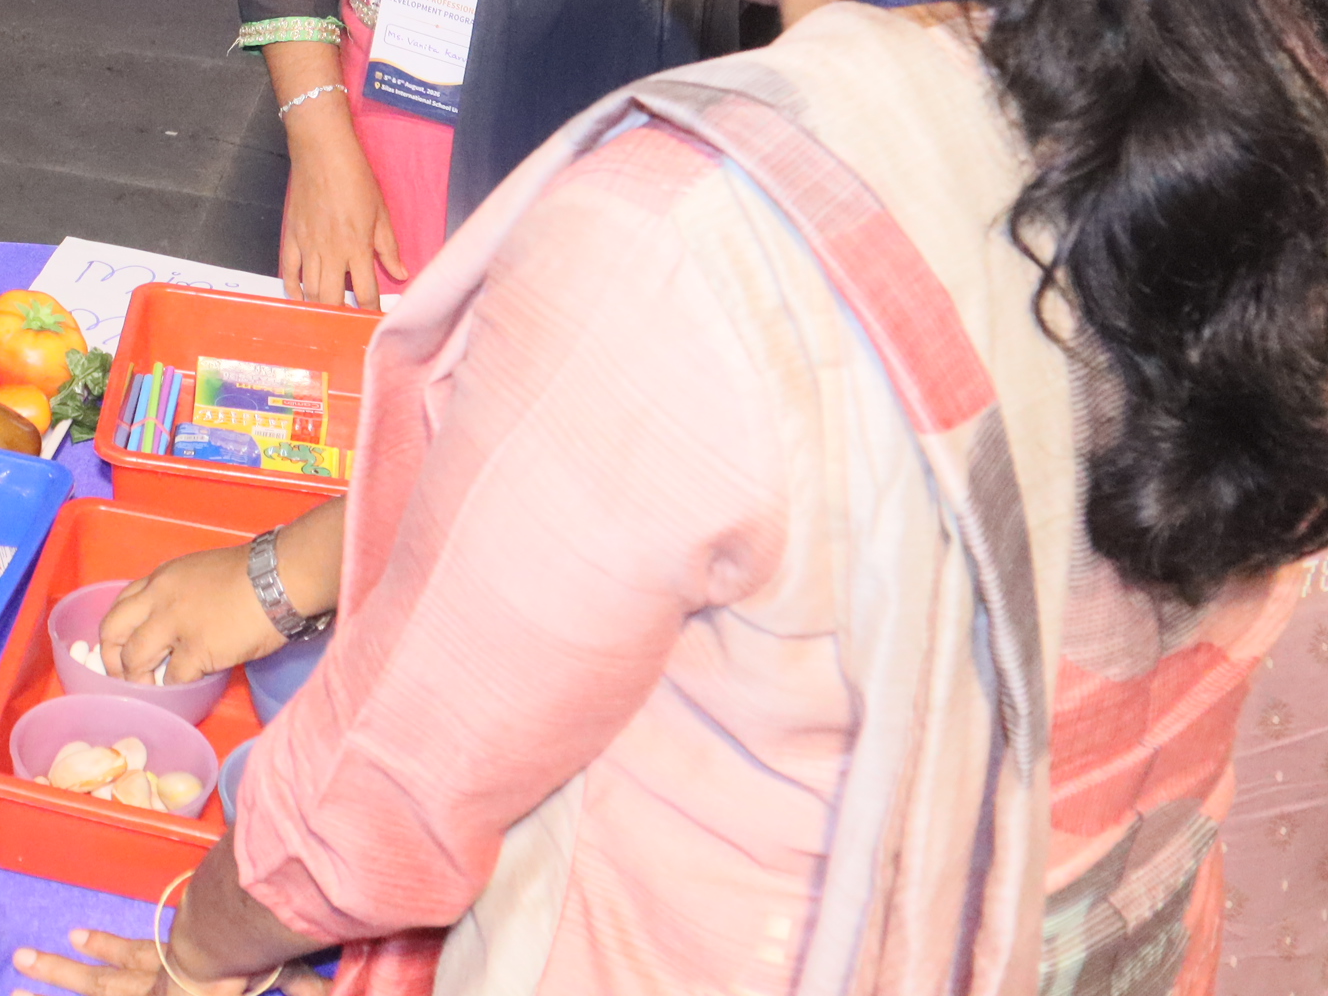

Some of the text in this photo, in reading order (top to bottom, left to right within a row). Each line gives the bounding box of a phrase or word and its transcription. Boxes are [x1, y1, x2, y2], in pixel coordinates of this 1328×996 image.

[395, 88, 432, 105] International
[432, 100, 451, 111] School
[283, 400, 320, 410] Camlin
